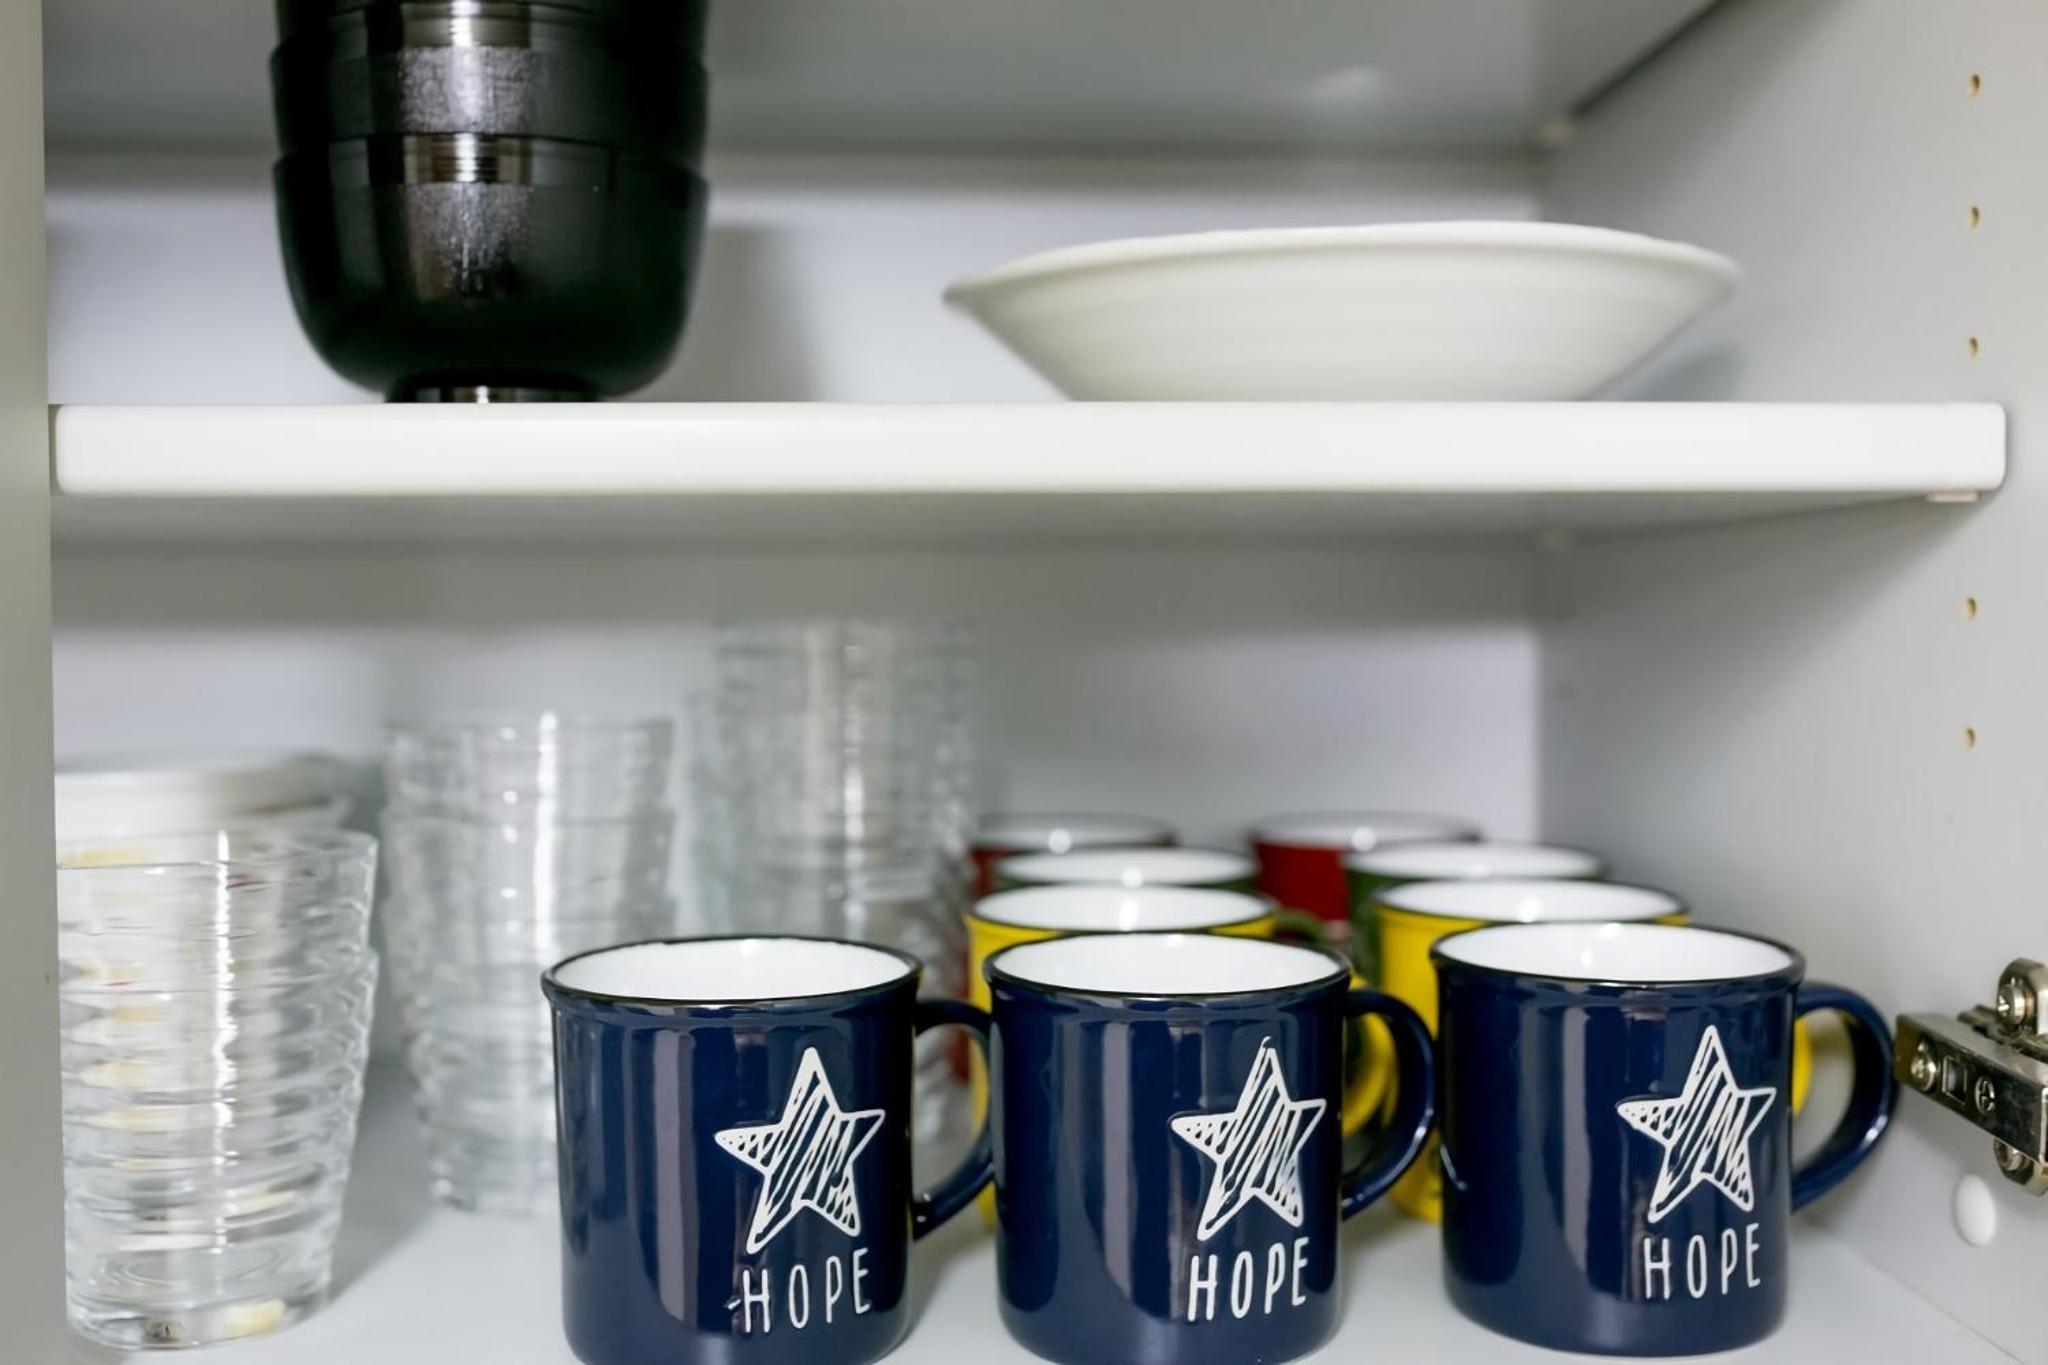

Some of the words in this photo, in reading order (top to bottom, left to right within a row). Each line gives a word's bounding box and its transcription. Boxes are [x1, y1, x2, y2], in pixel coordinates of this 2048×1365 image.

[742, 1248, 870, 1333] HOPE
[1187, 1237, 1308, 1322] HOPE
[1643, 1222, 1761, 1300] HOPE
